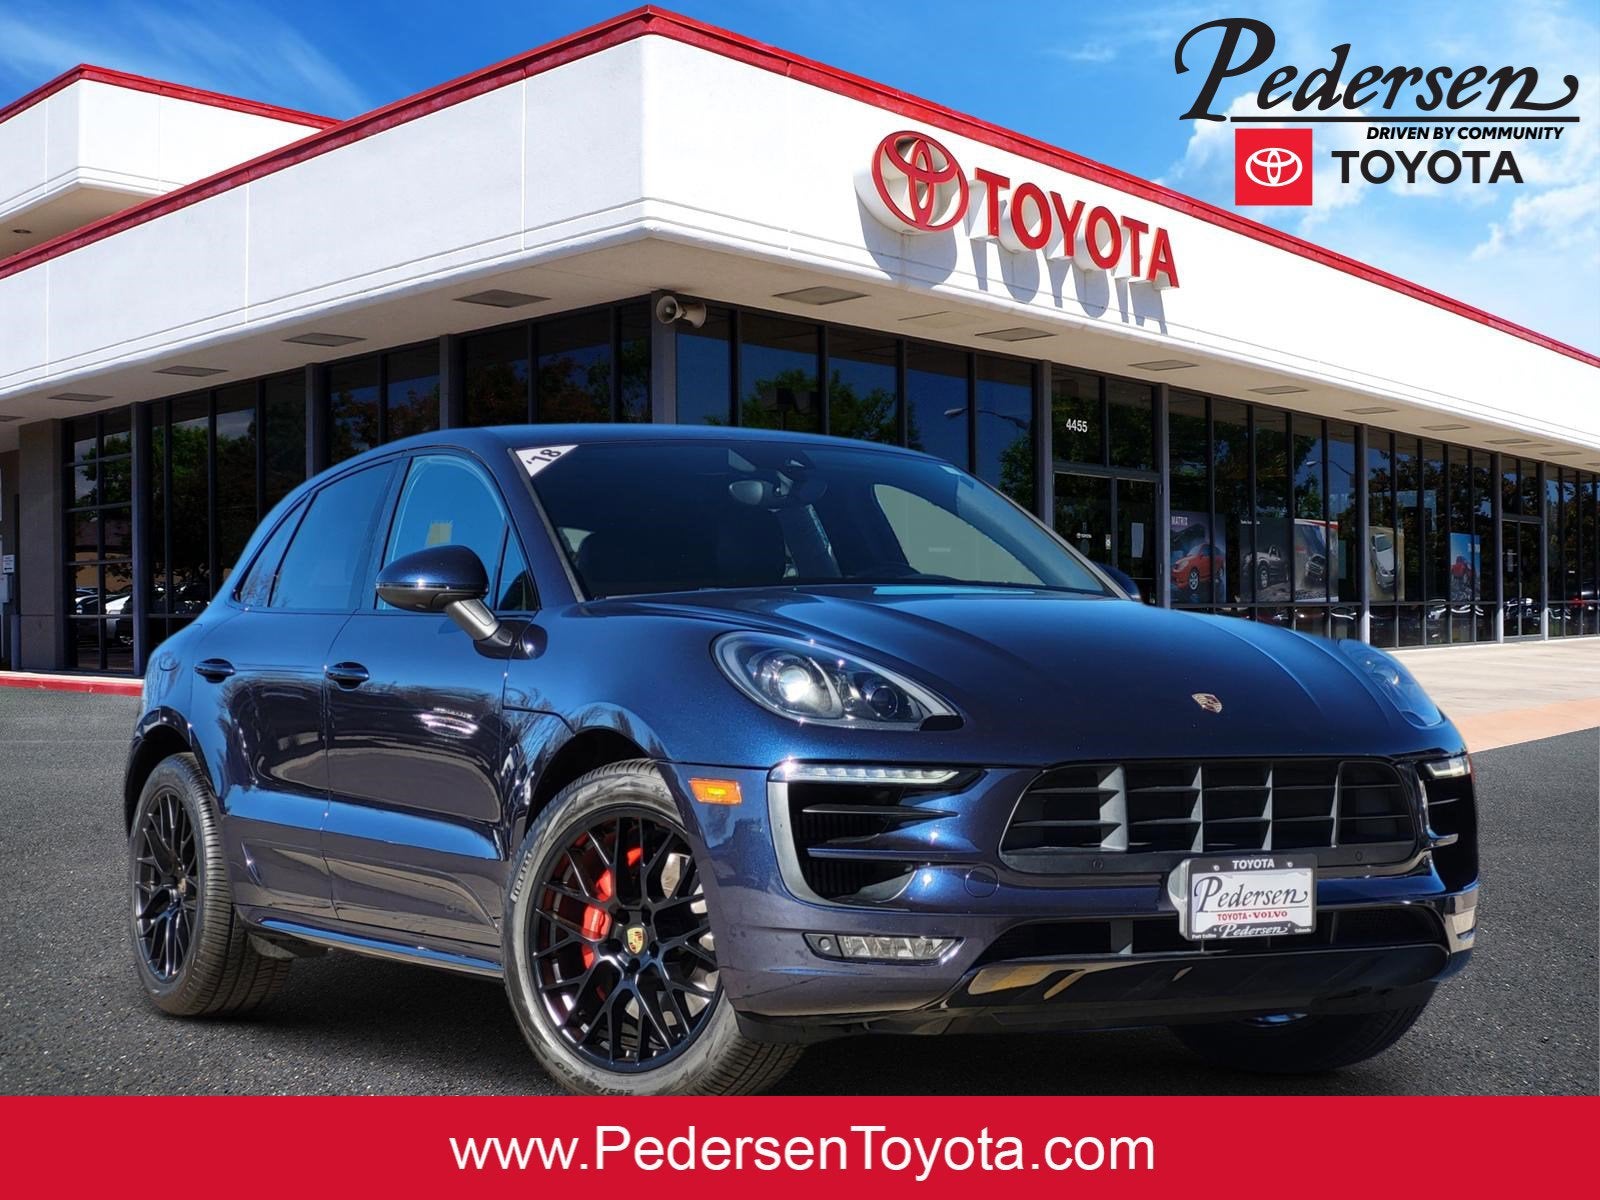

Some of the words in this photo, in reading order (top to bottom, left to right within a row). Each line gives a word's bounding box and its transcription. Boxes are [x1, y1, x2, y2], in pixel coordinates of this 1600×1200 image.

[975, 167, 1180, 288] TOYOTA
[1065, 418, 1088, 432] 4455
[1171, 516, 1188, 526] MATRIX
[1232, 858, 1275, 870] TOYOTA
[1194, 876, 1308, 913] Pedersen
[1217, 913, 1248, 922] TOYOTA
[1253, 910, 1288, 919] VOLVO
[1219, 923, 1289, 938] Pedersen
